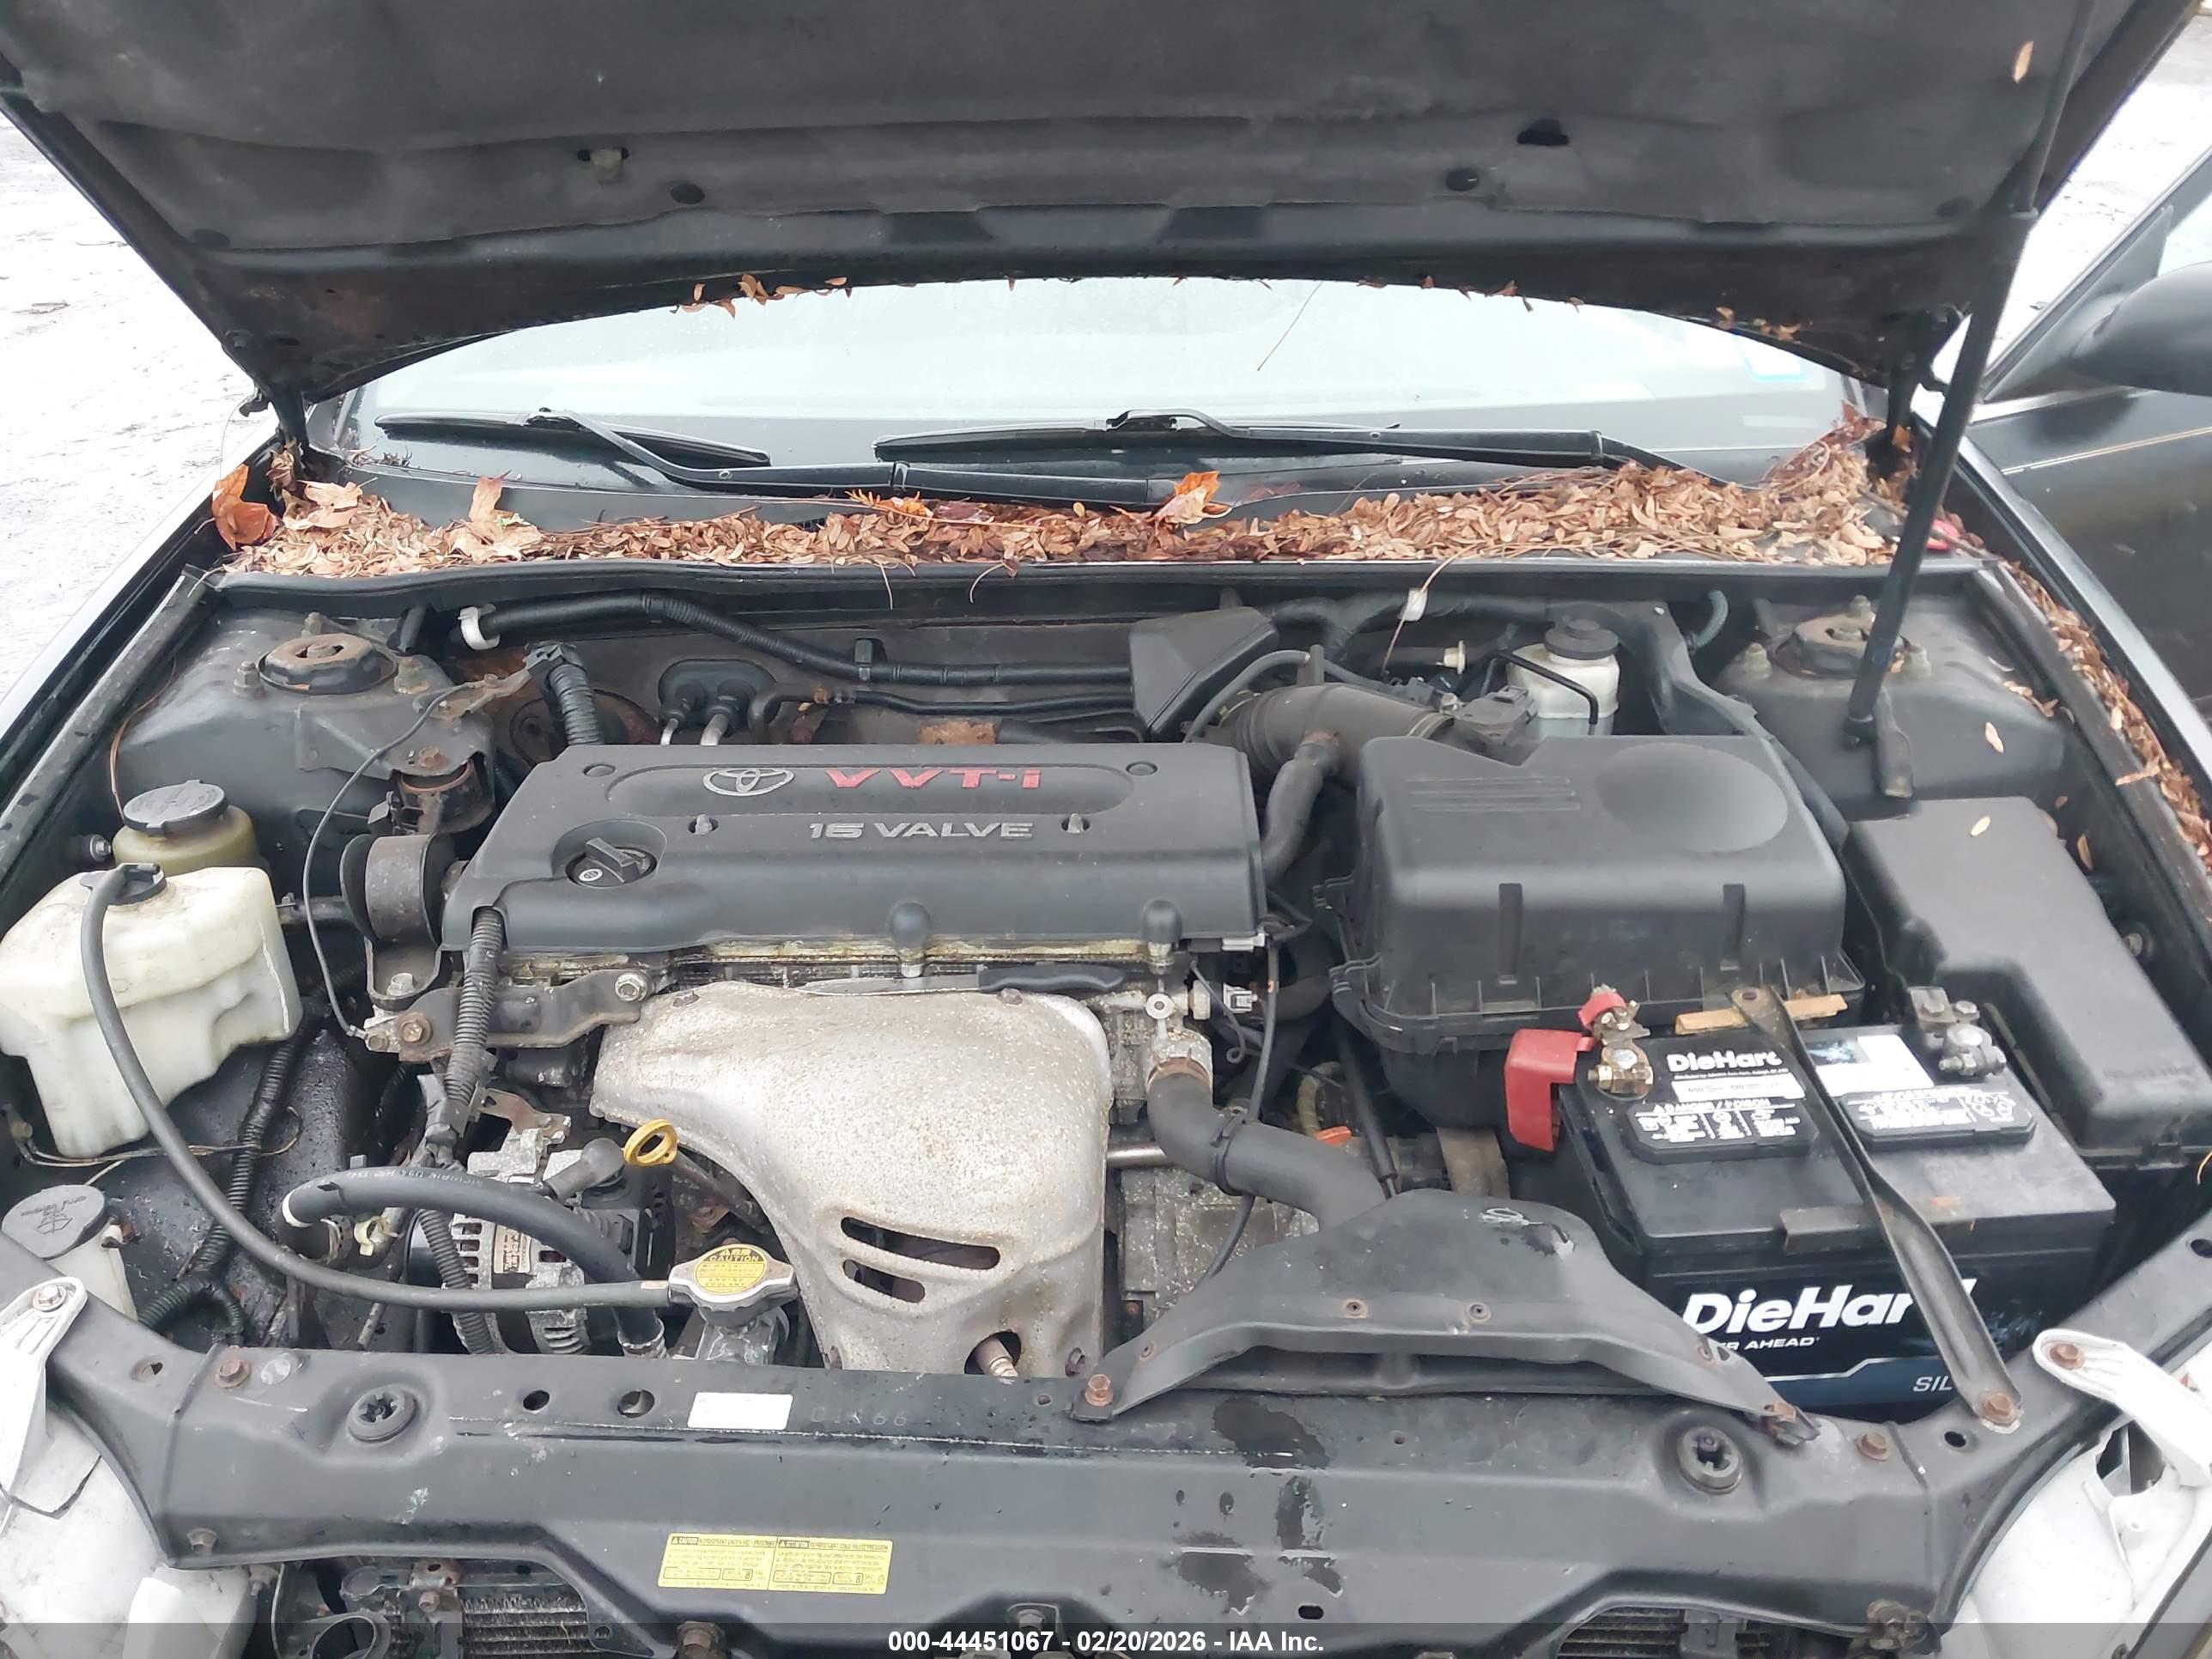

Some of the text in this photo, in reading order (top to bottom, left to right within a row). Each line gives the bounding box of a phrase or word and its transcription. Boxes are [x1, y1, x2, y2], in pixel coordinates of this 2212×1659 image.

[825, 769, 1042, 788] VVT-i
[810, 822, 1034, 838] 16 VALVE
[1682, 1279, 1977, 1335] DieHar
